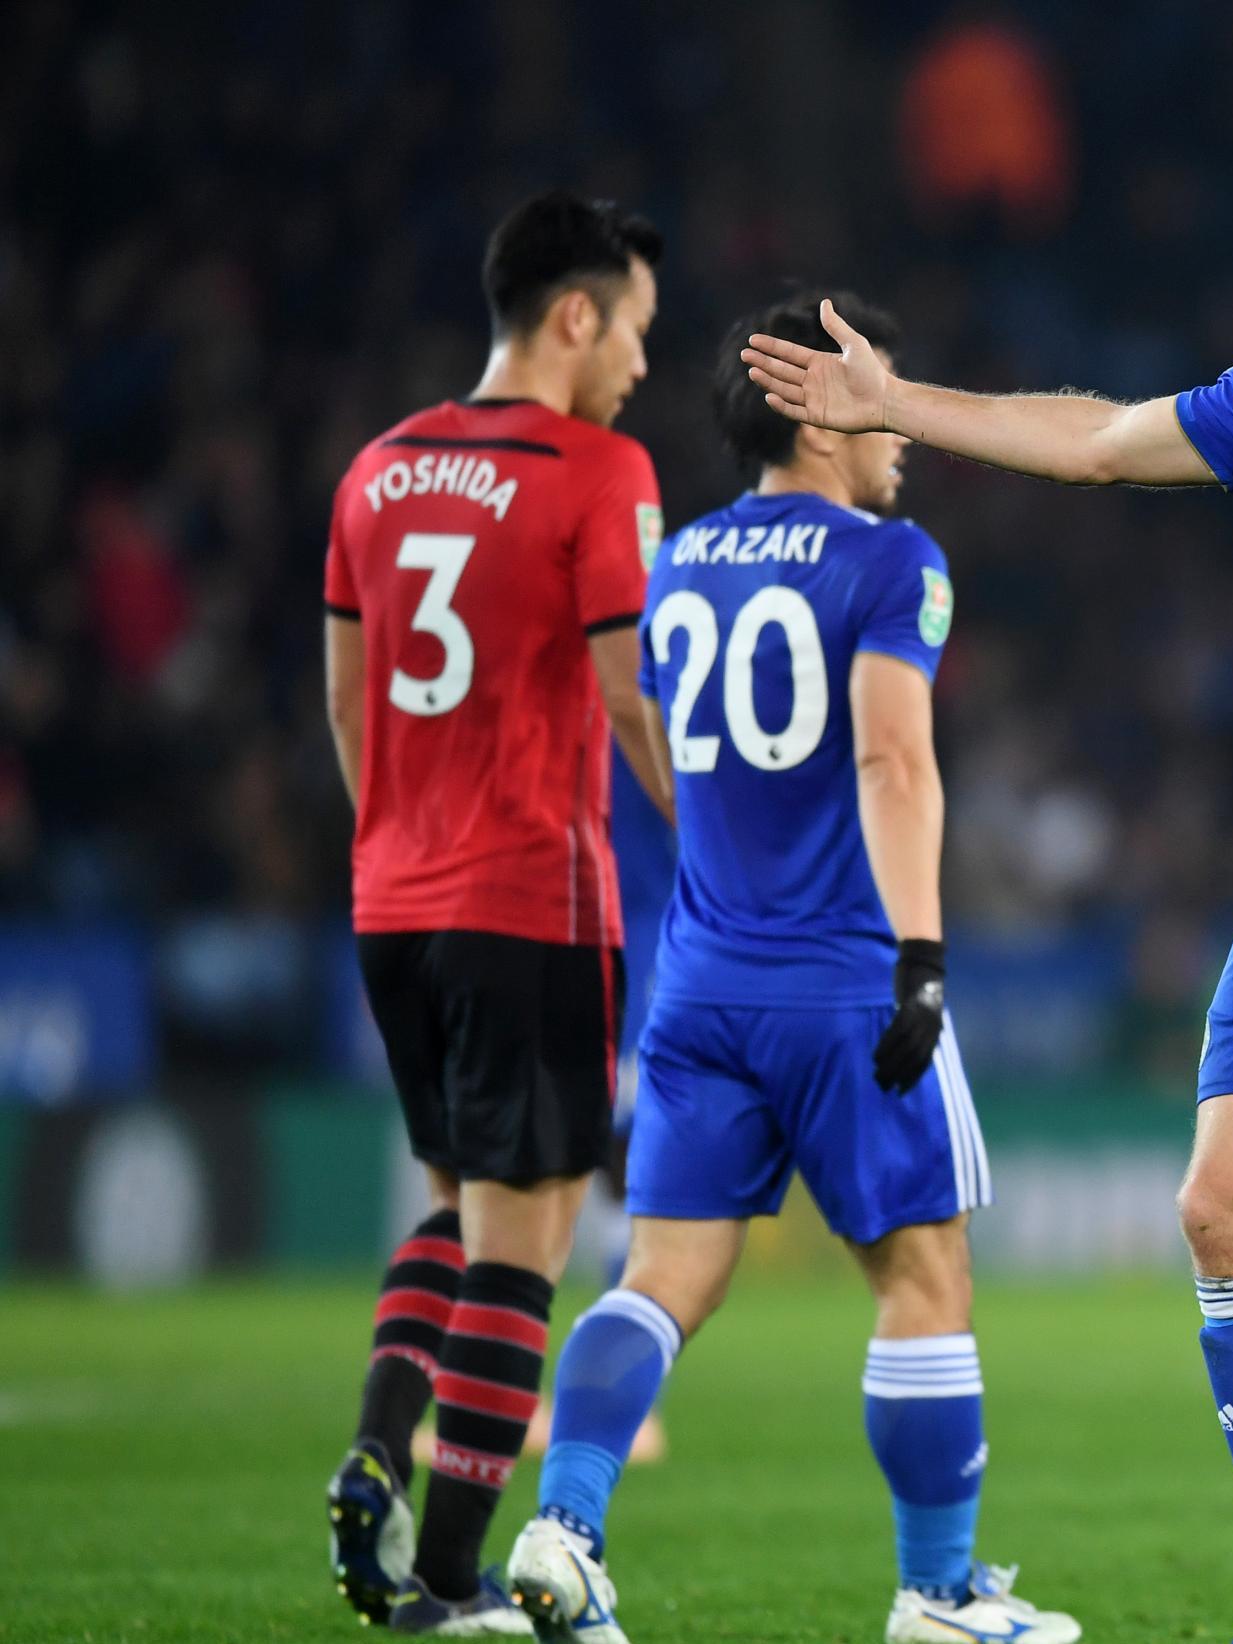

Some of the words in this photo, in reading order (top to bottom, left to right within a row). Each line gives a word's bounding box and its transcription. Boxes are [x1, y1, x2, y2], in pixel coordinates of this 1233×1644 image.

[364, 453, 519, 523] YOSHIDA
[671, 523, 829, 566] OKAZAKI
[388, 533, 476, 717] 3
[650, 585, 829, 774] 20
